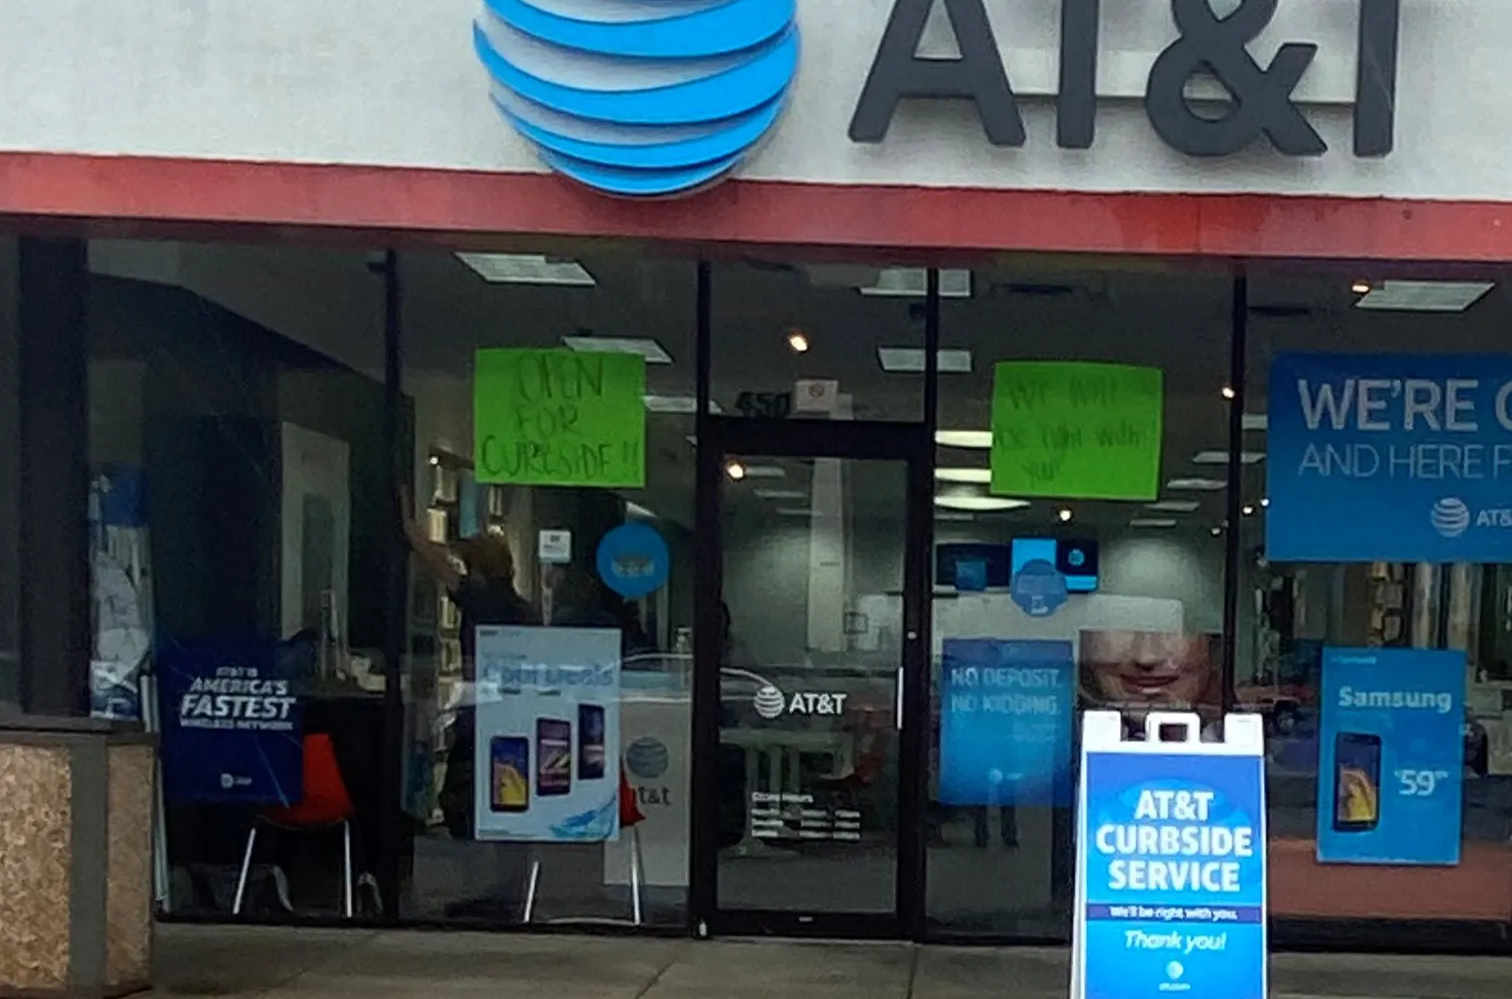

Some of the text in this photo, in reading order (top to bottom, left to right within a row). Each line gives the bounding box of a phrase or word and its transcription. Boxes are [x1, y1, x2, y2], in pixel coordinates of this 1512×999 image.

[1296, 378, 1480, 432] WE'RE
[515, 403, 582, 438] FOR
[1296, 442, 1381, 478] AND
[1388, 443, 1485, 480] HERE
[189, 676, 289, 695] AMERICA'S
[951, 666, 979, 686] NO
[180, 693, 297, 720] FASTEST
[788, 692, 848, 715] AT&T
[951, 693, 979, 712] NO
[1338, 685, 1452, 714] Samsung
[637, 785, 671, 807] t&t
[1134, 789, 1214, 821] AT&T
[1095, 823, 1254, 858] CURBSIDE
[1107, 859, 1241, 892] SERVICE
[1124, 929, 1228, 955] Thank you!
